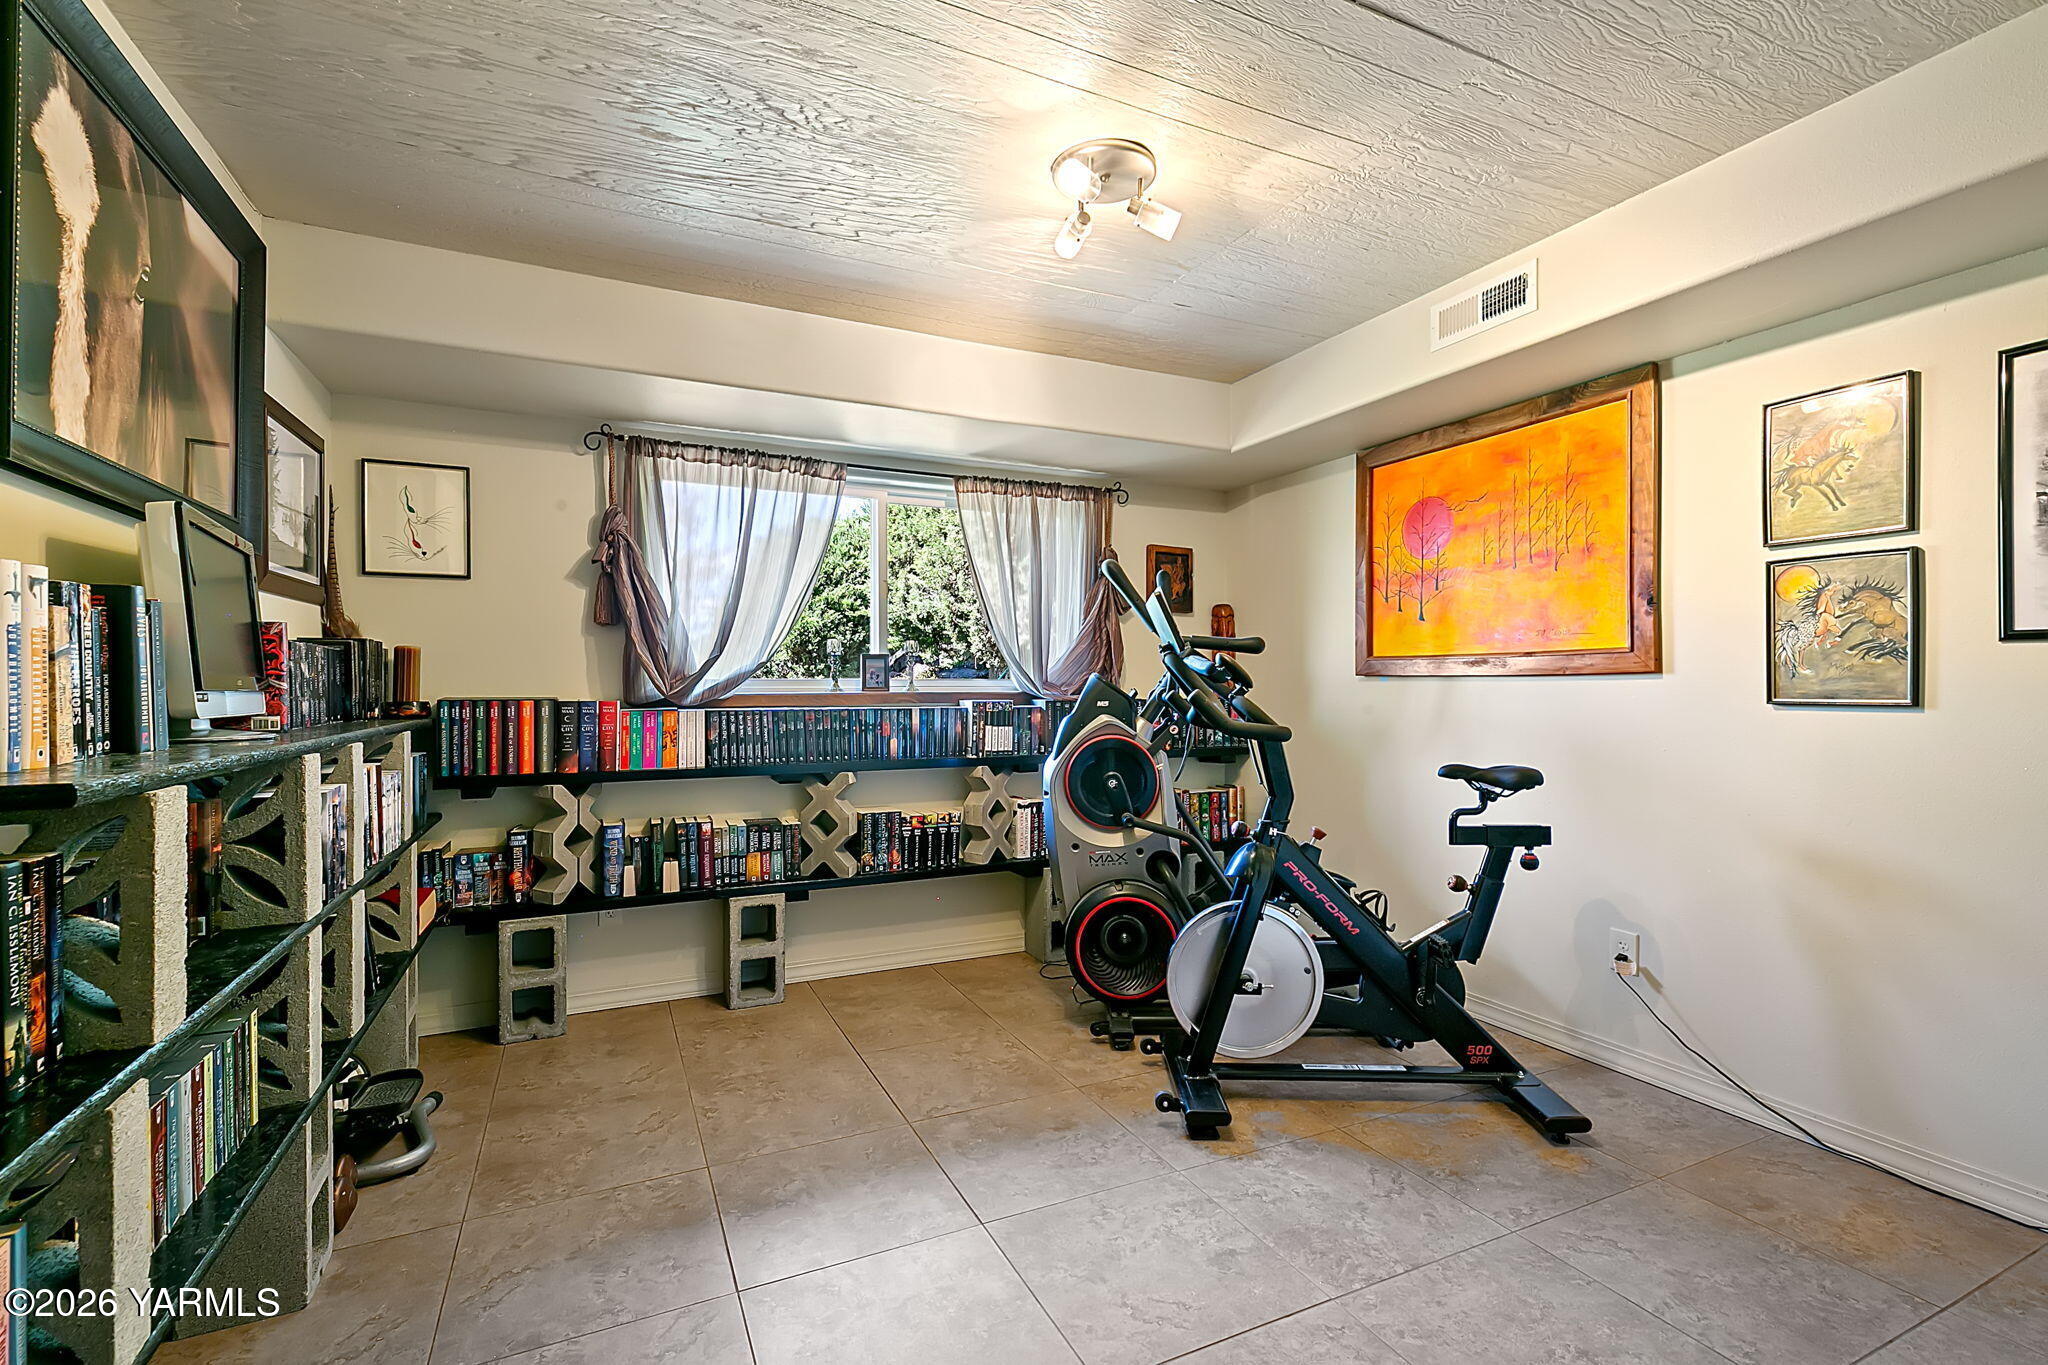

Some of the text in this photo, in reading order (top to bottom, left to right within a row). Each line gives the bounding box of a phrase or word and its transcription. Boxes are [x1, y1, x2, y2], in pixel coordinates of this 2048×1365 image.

[136, 607, 145, 638] DEVILS
[85, 650, 93, 700] COUNTRY
[1089, 852, 1127, 863] MAX
[1283, 861, 1360, 935] PRO-FORM
[7, 876, 20, 1007] IAN C. ESSLEMONT
[1467, 1046, 1492, 1055] 500
[1470, 1056, 1489, 1064] SPX
